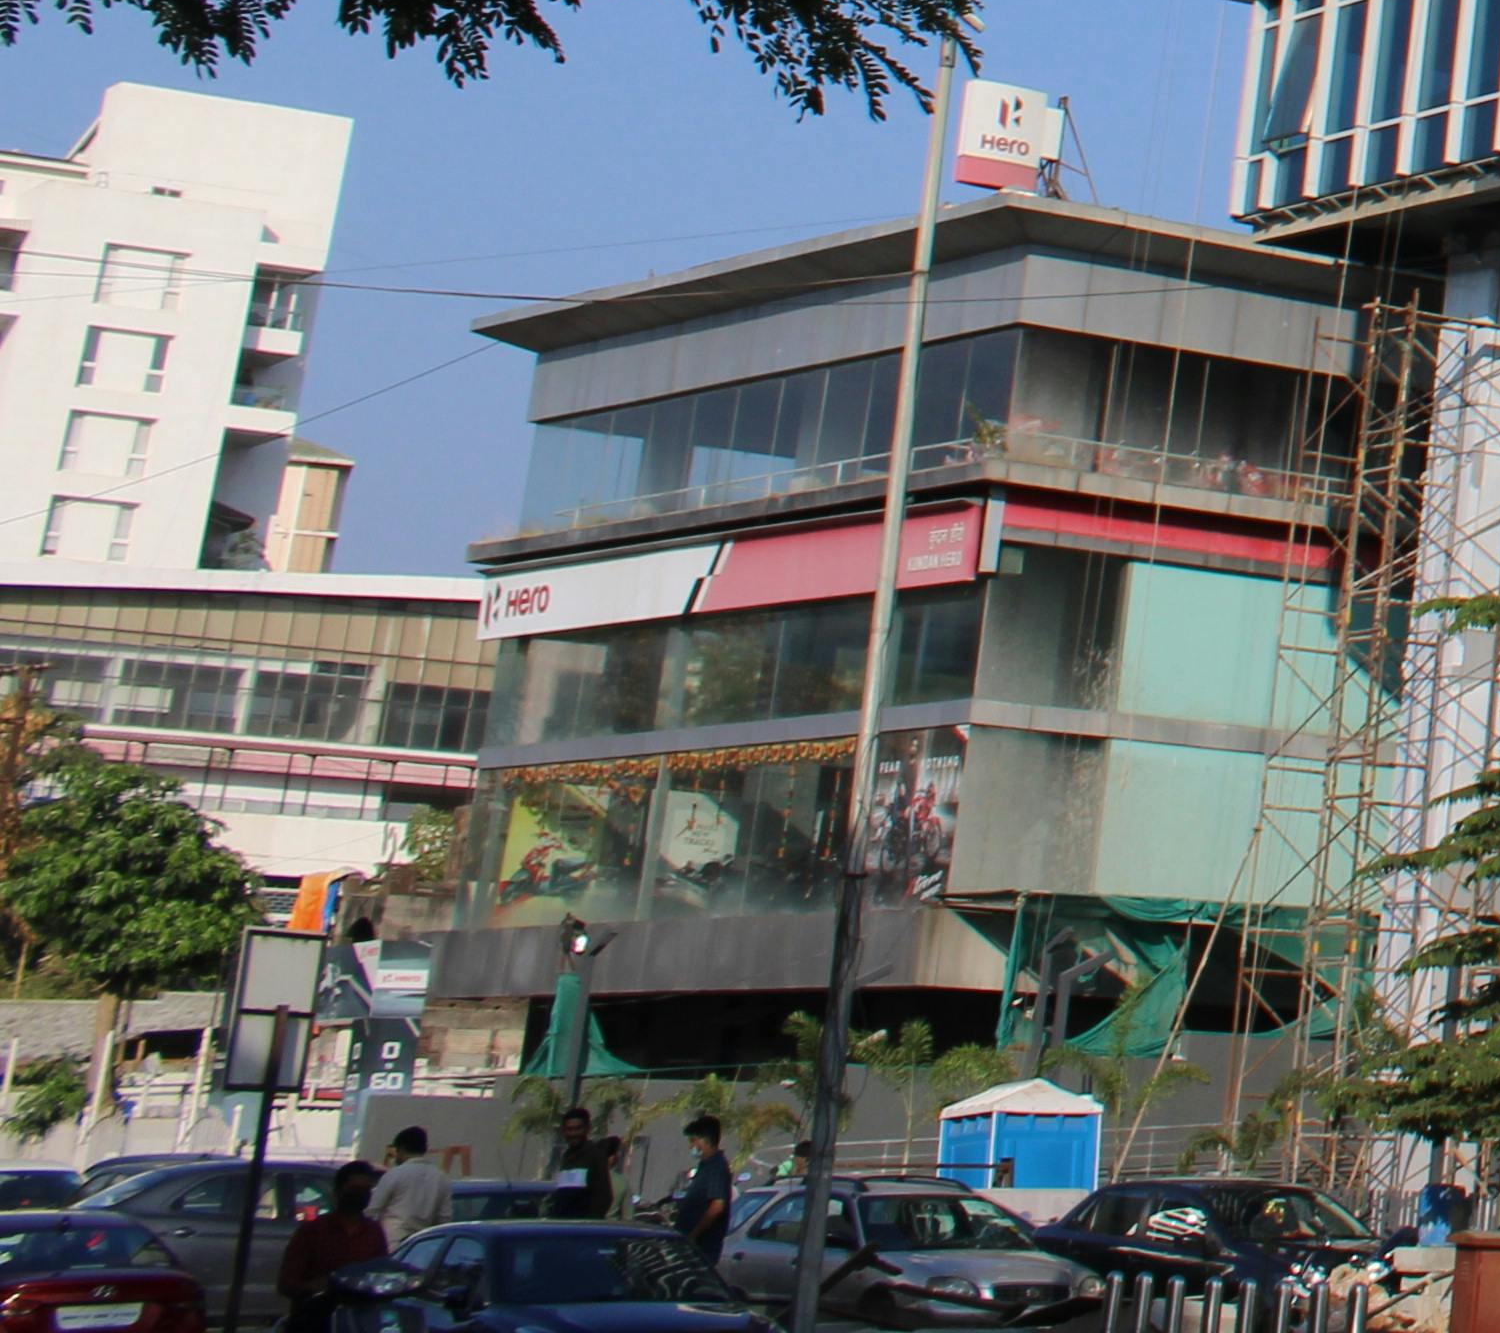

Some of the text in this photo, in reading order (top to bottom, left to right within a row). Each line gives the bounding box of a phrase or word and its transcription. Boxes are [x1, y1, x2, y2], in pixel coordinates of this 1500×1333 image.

[980, 134, 1030, 156] Hero
[505, 584, 550, 618] Hero
[369, 1071, 405, 1090] 60
